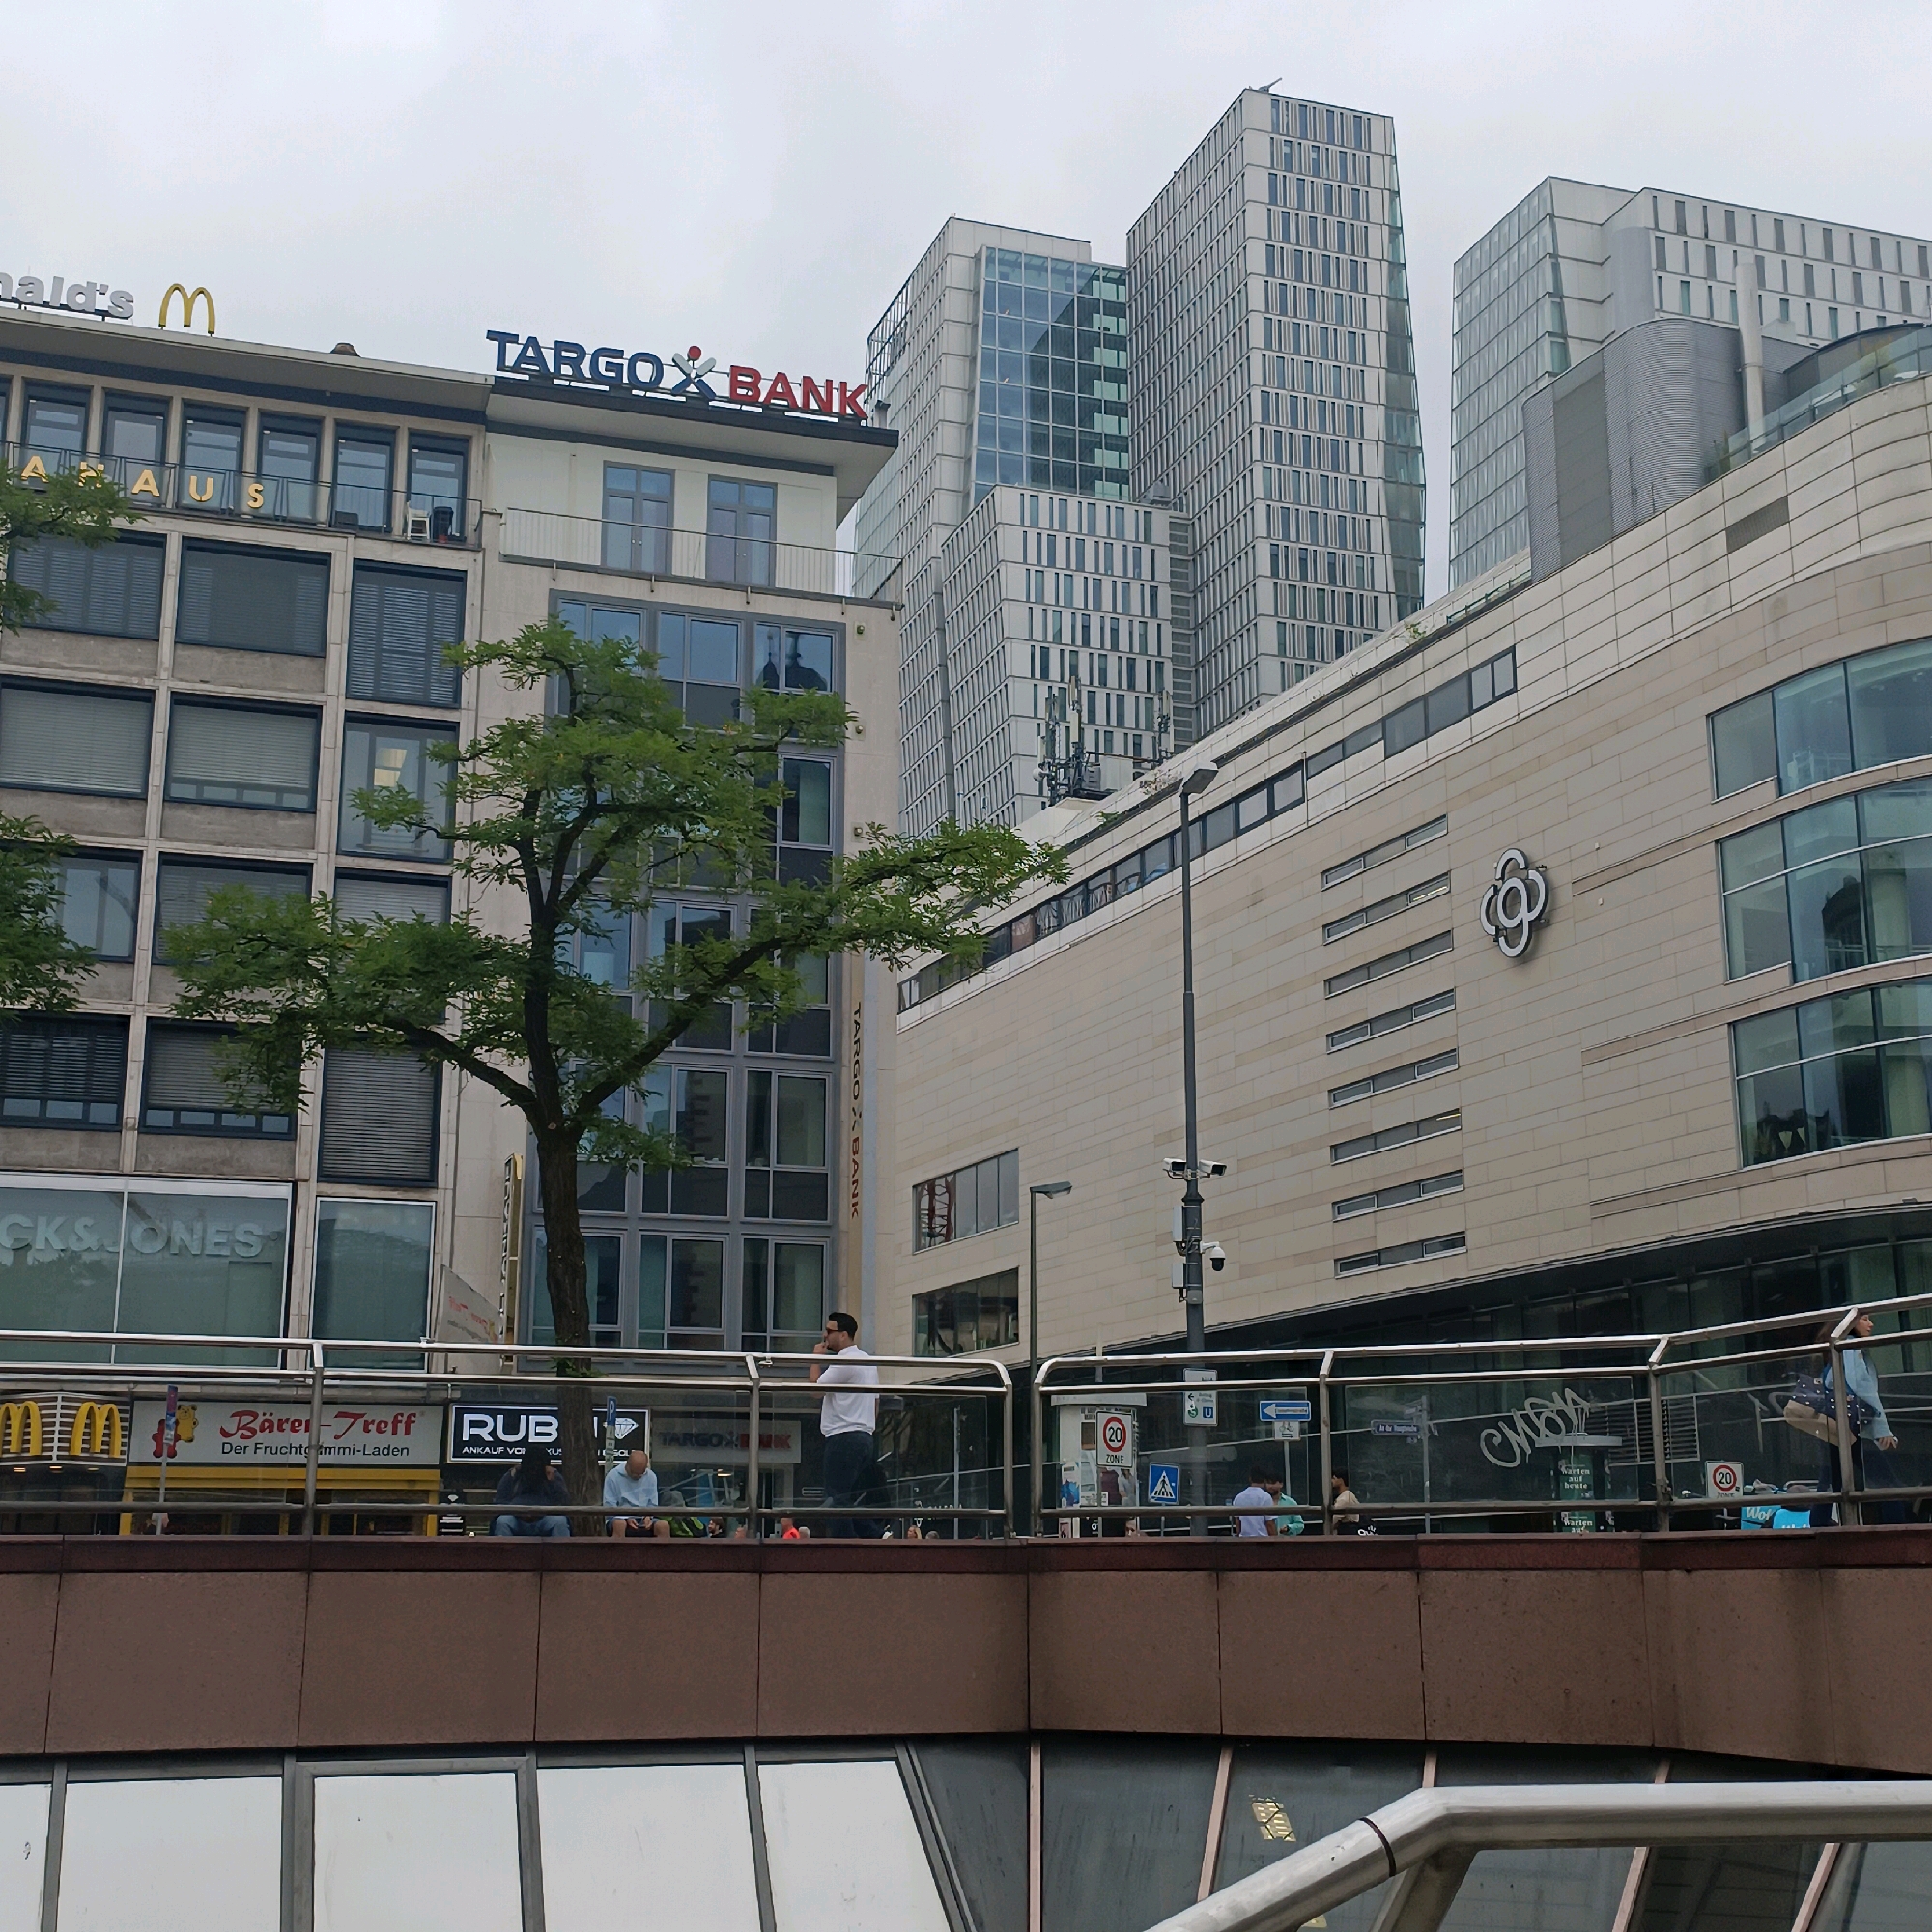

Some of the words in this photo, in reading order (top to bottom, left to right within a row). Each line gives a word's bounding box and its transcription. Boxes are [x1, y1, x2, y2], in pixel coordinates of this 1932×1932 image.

[486, 329, 665, 388] TARGO
[728, 364, 869, 419] BANK
[852, 1002, 862, 1101] TARGO
[609, 1400, 615, 1421] P
[1205, 1407, 1212, 1418] U
[220, 1410, 416, 1439] Bäre-Treff
[659, 1432, 723, 1447] TARGO
[1108, 1426, 1122, 1443] 20
[221, 1442, 249, 1455] Der
[462, 1446, 504, 1455] ANKAUF
[1106, 1454, 1124, 1464] ZONE
[1718, 1471, 1732, 1484] 20
